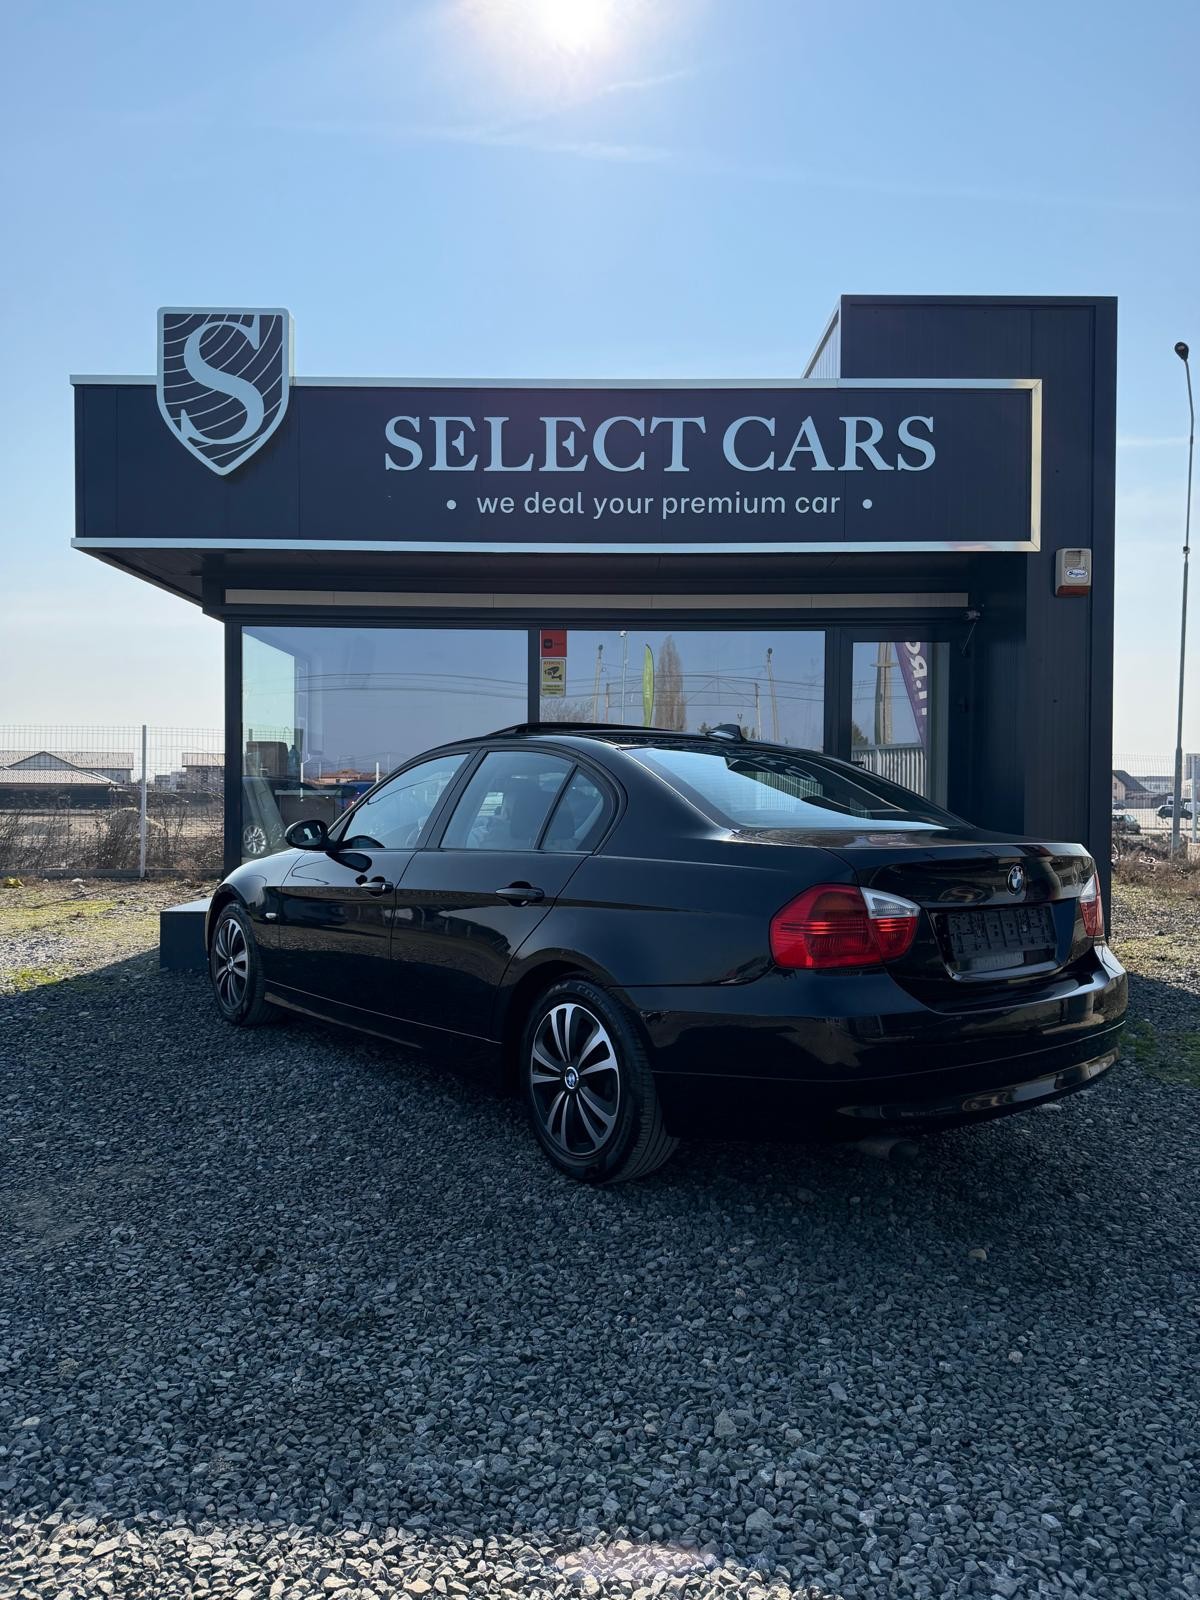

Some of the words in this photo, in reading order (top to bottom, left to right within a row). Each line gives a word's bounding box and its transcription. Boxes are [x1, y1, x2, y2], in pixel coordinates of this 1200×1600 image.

[181, 314, 265, 445] S
[384, 415, 707, 472] SELECT
[722, 415, 937, 472] CARS
[476, 496, 515, 514] we
[524, 491, 585, 514] deal
[593, 496, 654, 520] your
[662, 491, 786, 520] premium
[795, 496, 841, 514] car
